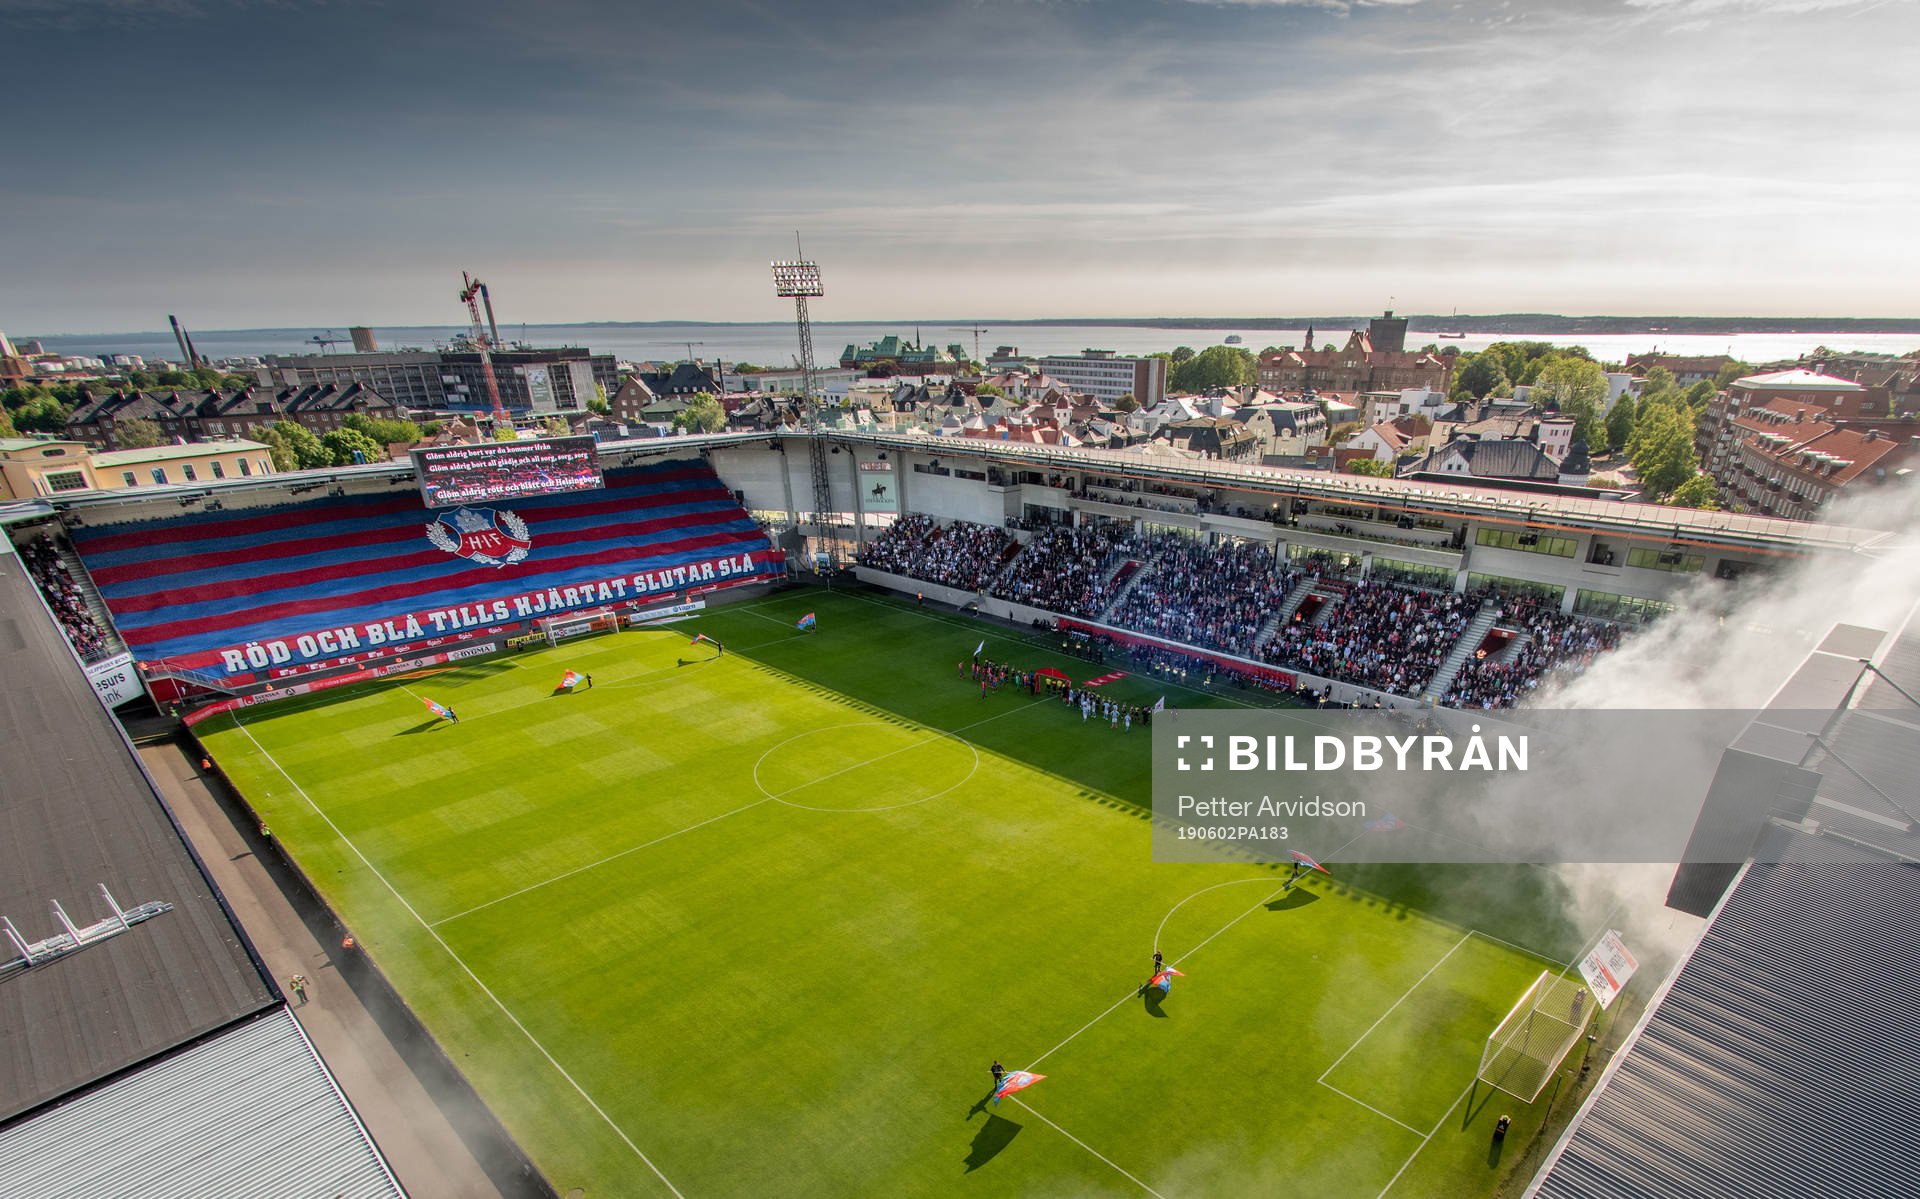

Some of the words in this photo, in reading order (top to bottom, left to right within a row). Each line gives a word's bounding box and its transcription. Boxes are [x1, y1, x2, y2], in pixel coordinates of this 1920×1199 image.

[446, 450, 468, 459] aldrig
[449, 462, 471, 471] aldrig
[518, 457, 530, 465] och
[574, 452, 588, 460] sorg
[436, 490, 460, 499] Glöm
[461, 488, 487, 497] aldrig
[487, 484, 504, 493] rött
[505, 483, 519, 491] och
[541, 479, 555, 487] och
[555, 475, 601, 487] Helsingborg
[220, 641, 292, 673] RÖD
[297, 627, 361, 658] OCH
[365, 614, 425, 645] BLÅ
[428, 601, 511, 632] TILLS
[514, 578, 627, 617] HJÄRTAT
[633, 562, 715, 594] SLUTAR
[718, 553, 755, 577] SLÅ
[460, 646, 490, 657] BYGMA
